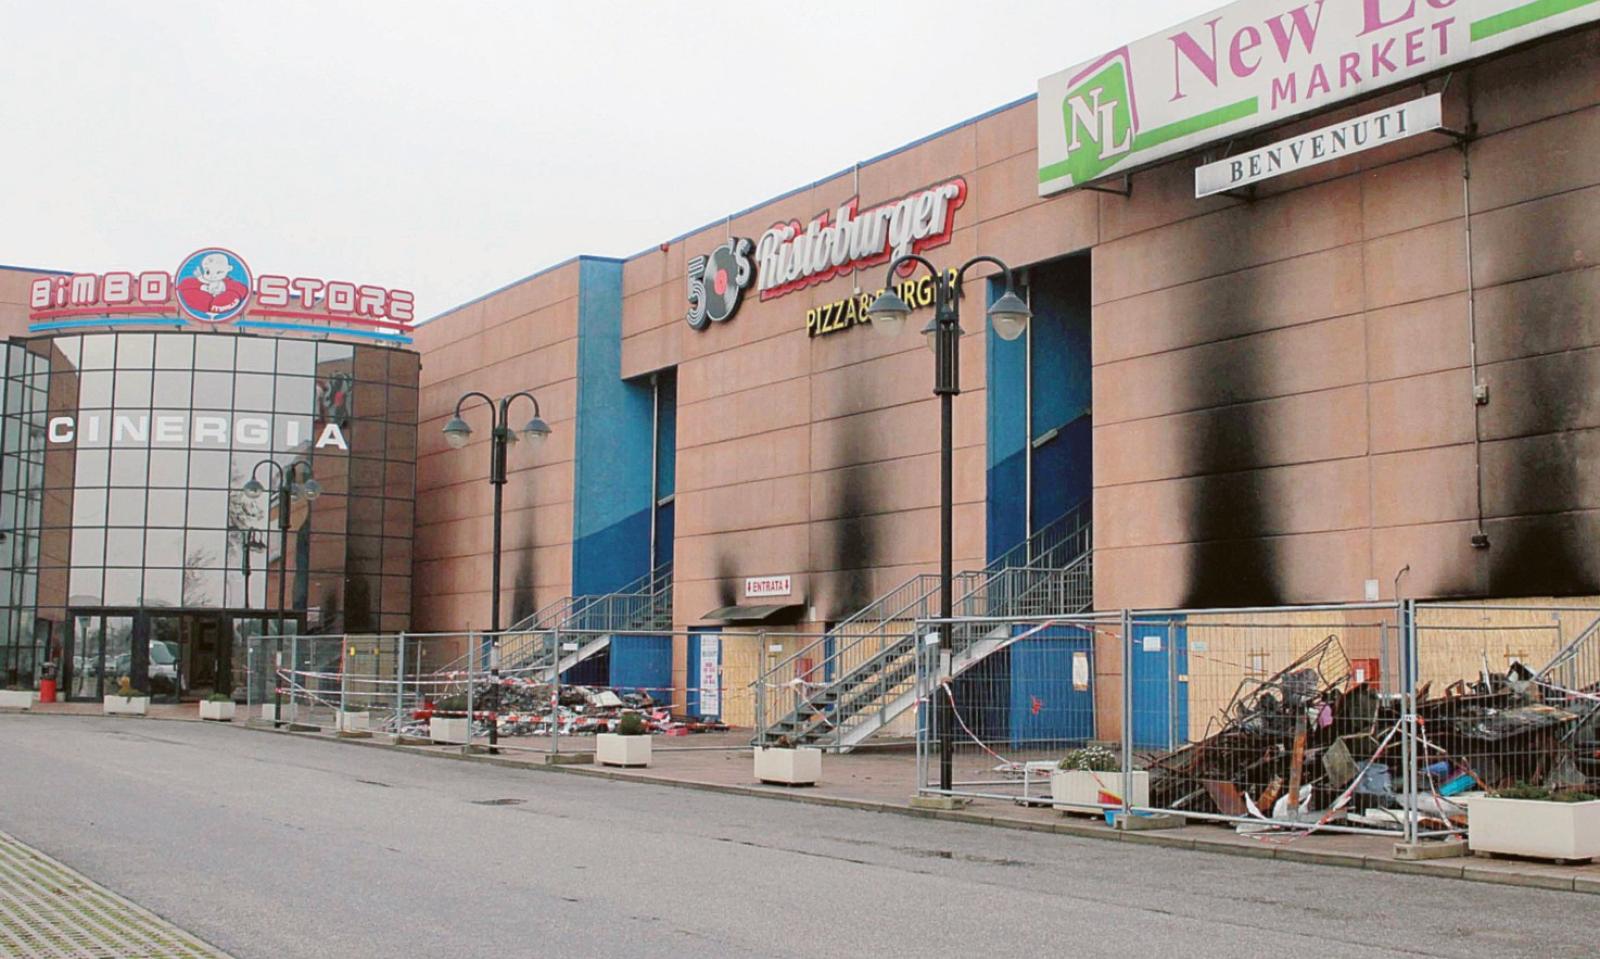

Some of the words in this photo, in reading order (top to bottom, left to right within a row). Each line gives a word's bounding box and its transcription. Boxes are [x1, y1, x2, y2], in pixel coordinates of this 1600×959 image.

[1168, 0, 1325, 102] New
[1271, 17, 1456, 111] MARKET
[1067, 87, 1132, 160] NL
[1230, 109, 1407, 184] BENVENUTI
[756, 181, 961, 292] Ristoburger
[258, 275, 414, 322] STORE
[48, 415, 350, 451] CINERGIA
[753, 580, 784, 593] ENTRATA
